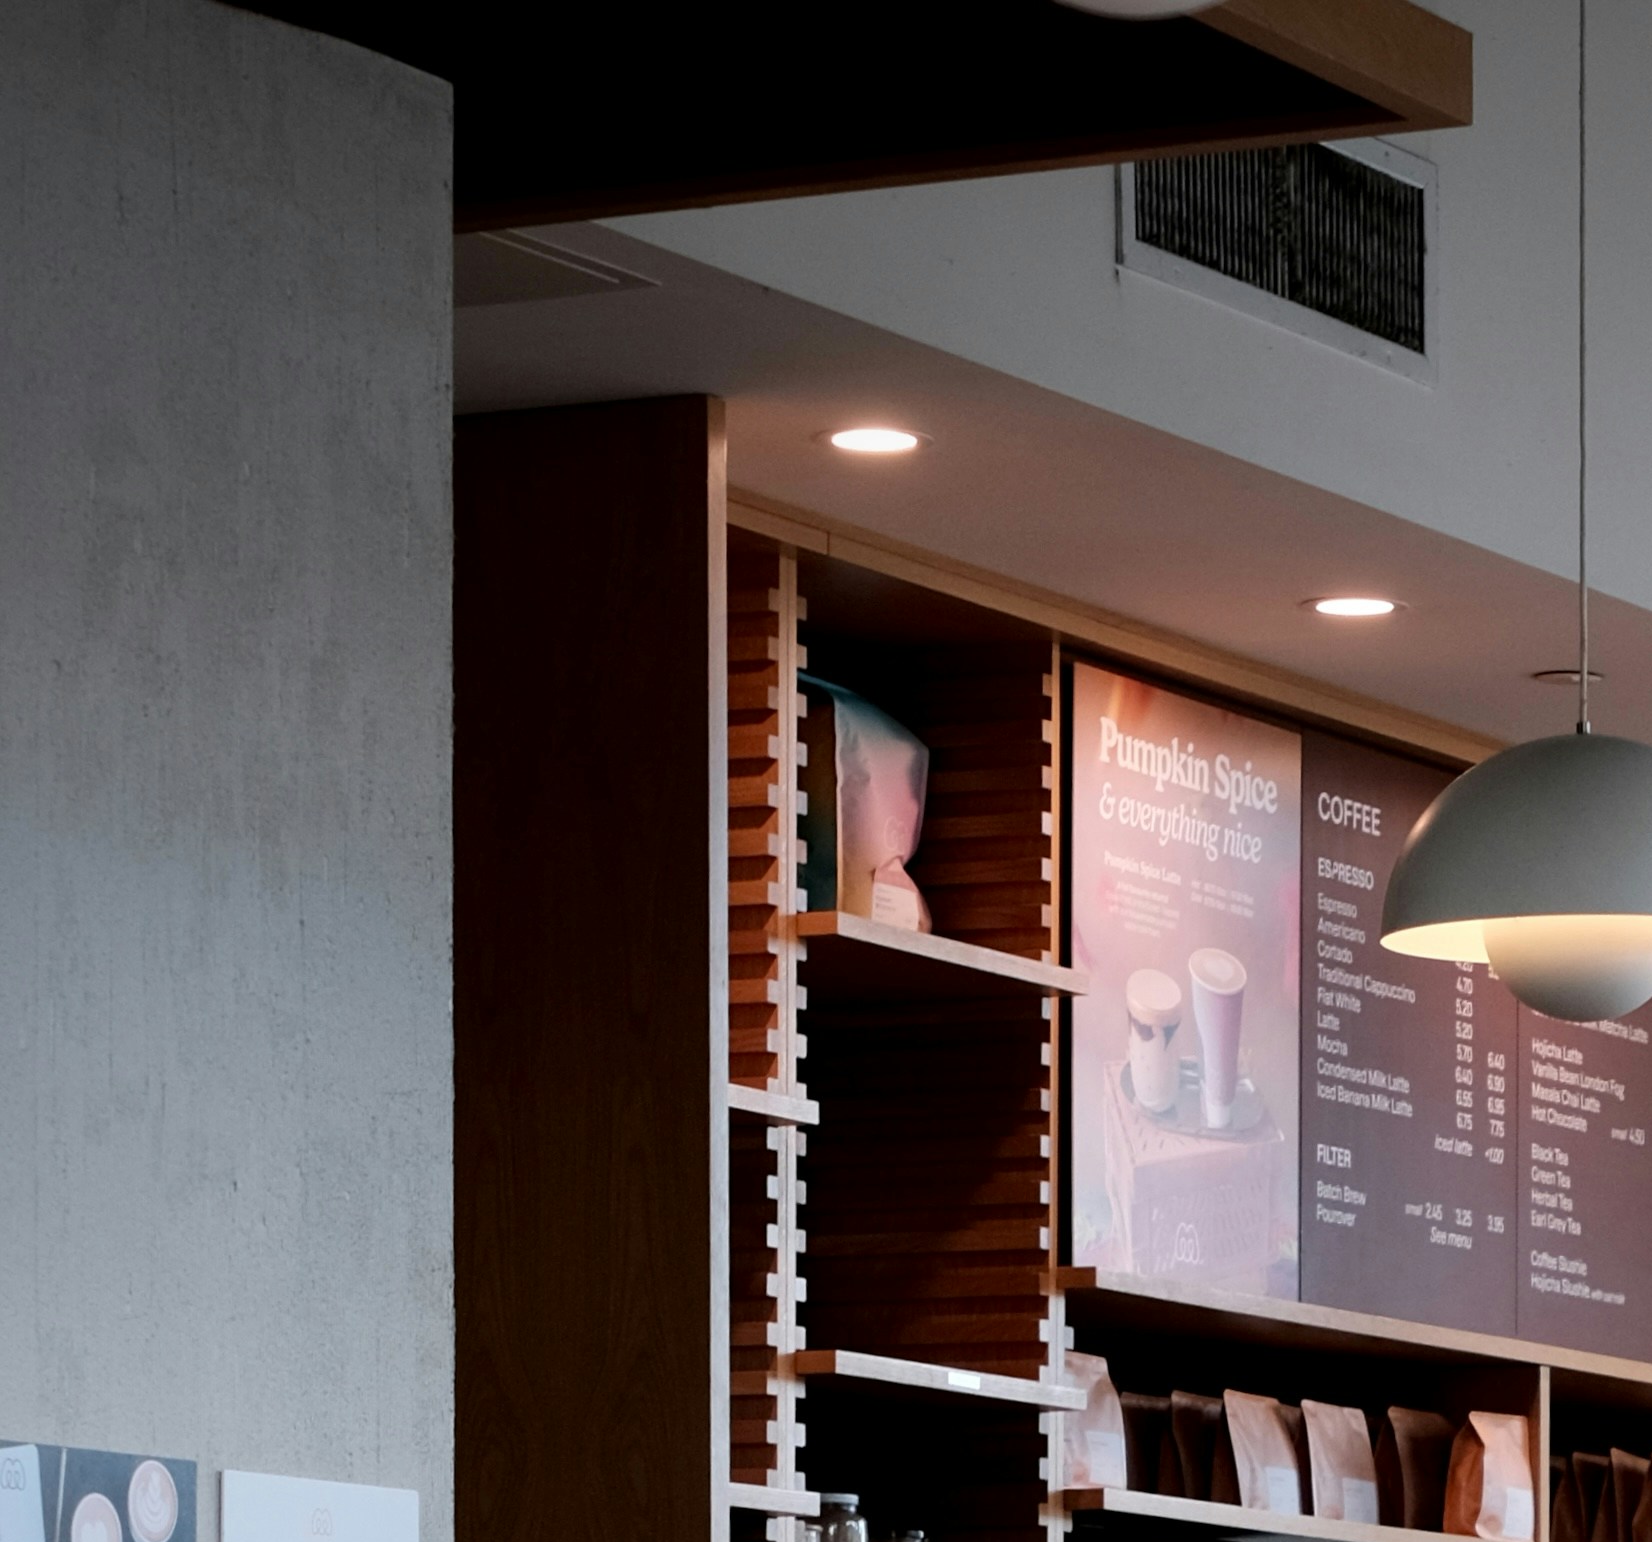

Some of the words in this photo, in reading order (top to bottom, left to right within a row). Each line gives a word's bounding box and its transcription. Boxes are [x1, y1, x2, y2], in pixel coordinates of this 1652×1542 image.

[1100, 716, 1210, 793] Pumpkin
[1215, 754, 1277, 814] Spice
[1100, 782, 1114, 819] &
[1119, 794, 1220, 862] everything
[1224, 823, 1261, 863] nice
[1318, 792, 1381, 837] COFFEE
[1104, 850, 1139, 874] Pumpkin
[1141, 859, 1160, 881] Spice
[1162, 867, 1181, 886] Latte
[1318, 857, 1374, 890] ESPRESSO
[1318, 892, 1357, 918] Espresso
[1318, 917, 1365, 944] Americano
[1318, 940, 1353, 964] Cortado
[1318, 963, 1363, 990] Traditional
[1364, 975, 1416, 1004] Cappuccino
[1456, 976, 1473, 994] 4.70
[1318, 987, 1334, 1006] Flat
[1335, 991, 1361, 1013] White
[1456, 998, 1473, 1017] 5.20
[1317, 1010, 1340, 1031] Latte
[1456, 1021, 1473, 1040] 5.20
[1317, 1035, 1348, 1056] Mocha
[1629, 1027, 1648, 1044] Latte
[1456, 1043, 1473, 1063] 5.70
[1532, 1037, 1562, 1059] Hojicha
[1563, 1046, 1583, 1065] Latte
[1317, 1057, 1367, 1084] Condensed
[1368, 1069, 1387, 1089] Milk
[1388, 1073, 1410, 1093] Latte
[1317, 1081, 1336, 1100] Iced
[1337, 1085, 1369, 1109] Banana
[1371, 1093, 1390, 1112] Milk
[1391, 1098, 1413, 1117] Latte
[1561, 1089, 1580, 1108] Chai
[1580, 1095, 1600, 1113] Latte
[1531, 1105, 1547, 1122] Hot
[1547, 1108, 1587, 1133] Chocolate
[1317, 1143, 1351, 1168] FILTER
[1531, 1143, 1555, 1163] Black
[1555, 1148, 1569, 1166] Tea
[1531, 1165, 1556, 1185] Green
[1557, 1171, 1571, 1189] Tea
[1317, 1180, 1342, 1201] Batch
[1343, 1185, 1367, 1206] Brew
[1531, 1188, 1558, 1208] Herbal
[1559, 1193, 1573, 1212] Tea
[1317, 1204, 1356, 1227] Pourover
[1531, 1209, 1547, 1227] Earl
[1547, 1213, 1567, 1235] Grey
[1567, 1217, 1581, 1236] Tea
[1430, 1226, 1447, 1244] See
[1447, 1232, 1472, 1249] menu
[1531, 1250, 1557, 1271] Coffee
[1531, 1273, 1561, 1293] Hojicha
